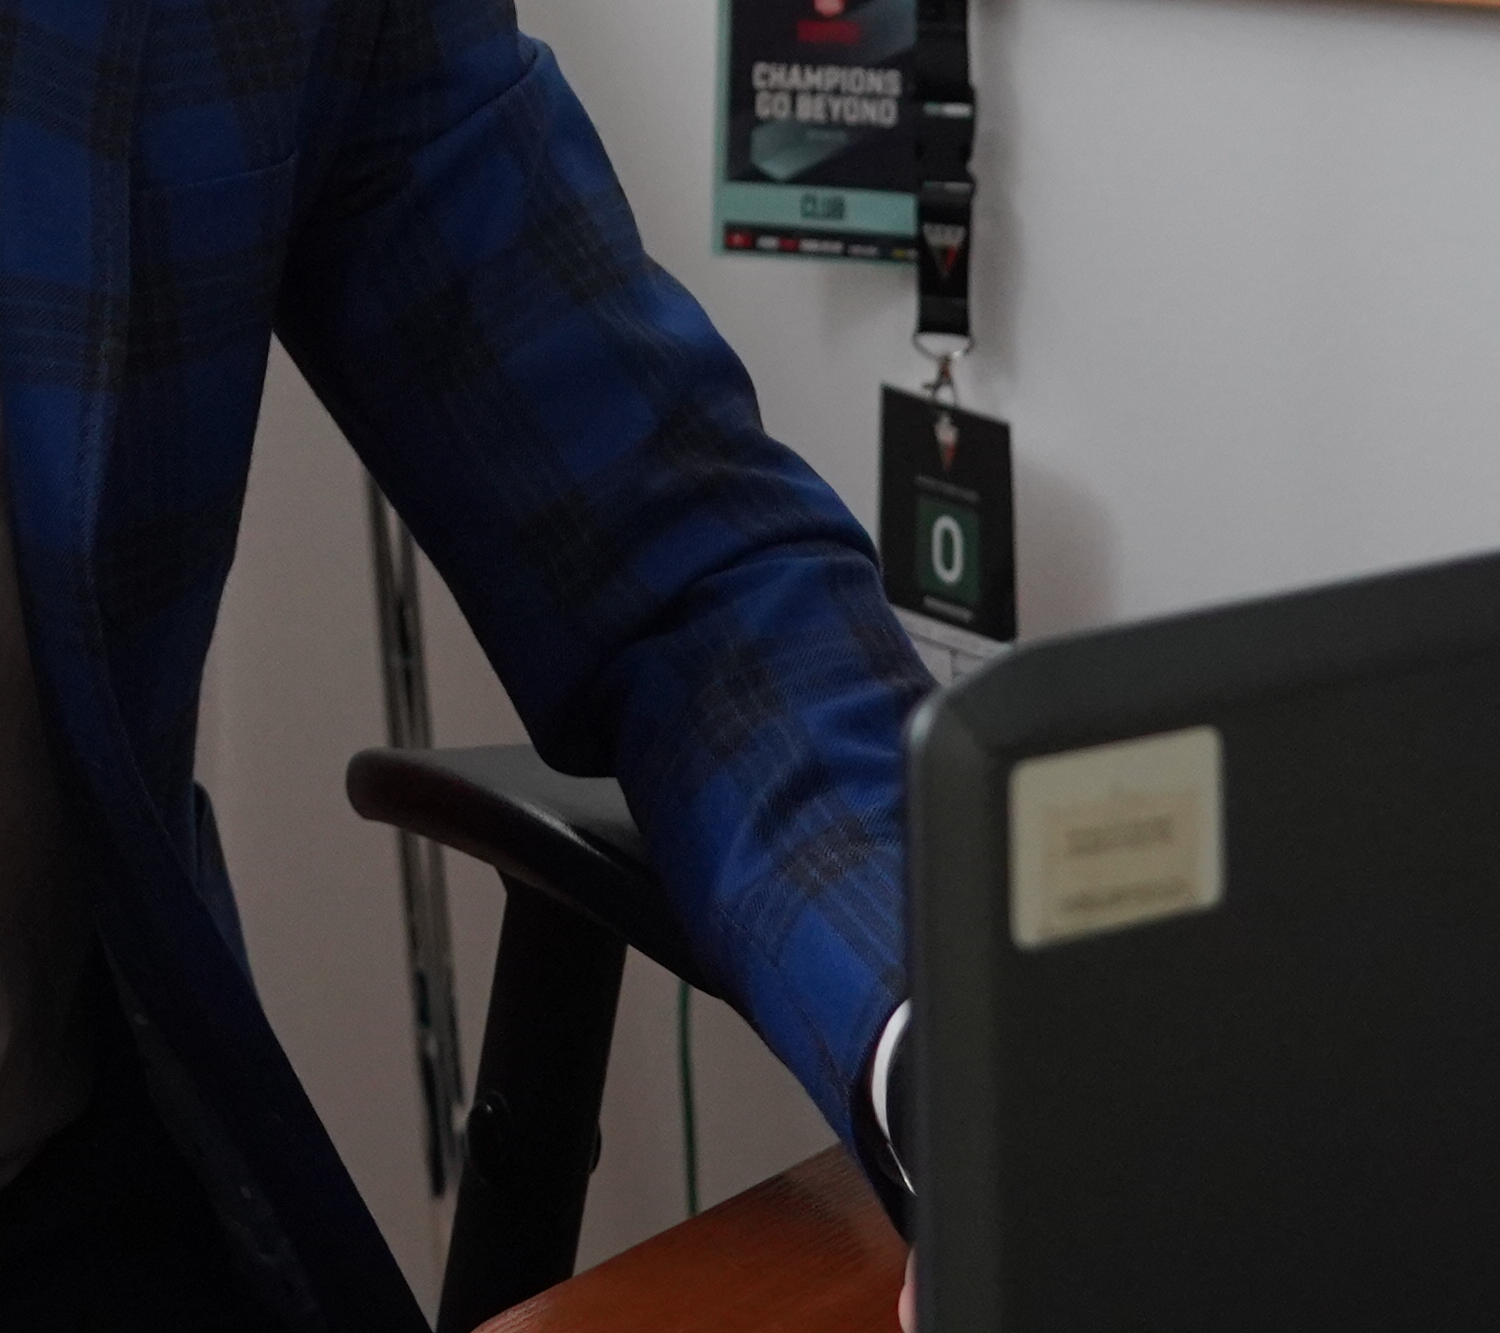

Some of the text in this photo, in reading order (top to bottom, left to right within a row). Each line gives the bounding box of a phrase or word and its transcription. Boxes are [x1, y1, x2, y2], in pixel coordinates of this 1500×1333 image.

[752, 61, 902, 97] CHAMPIONS
[755, 91, 899, 129] GO BEYOND
